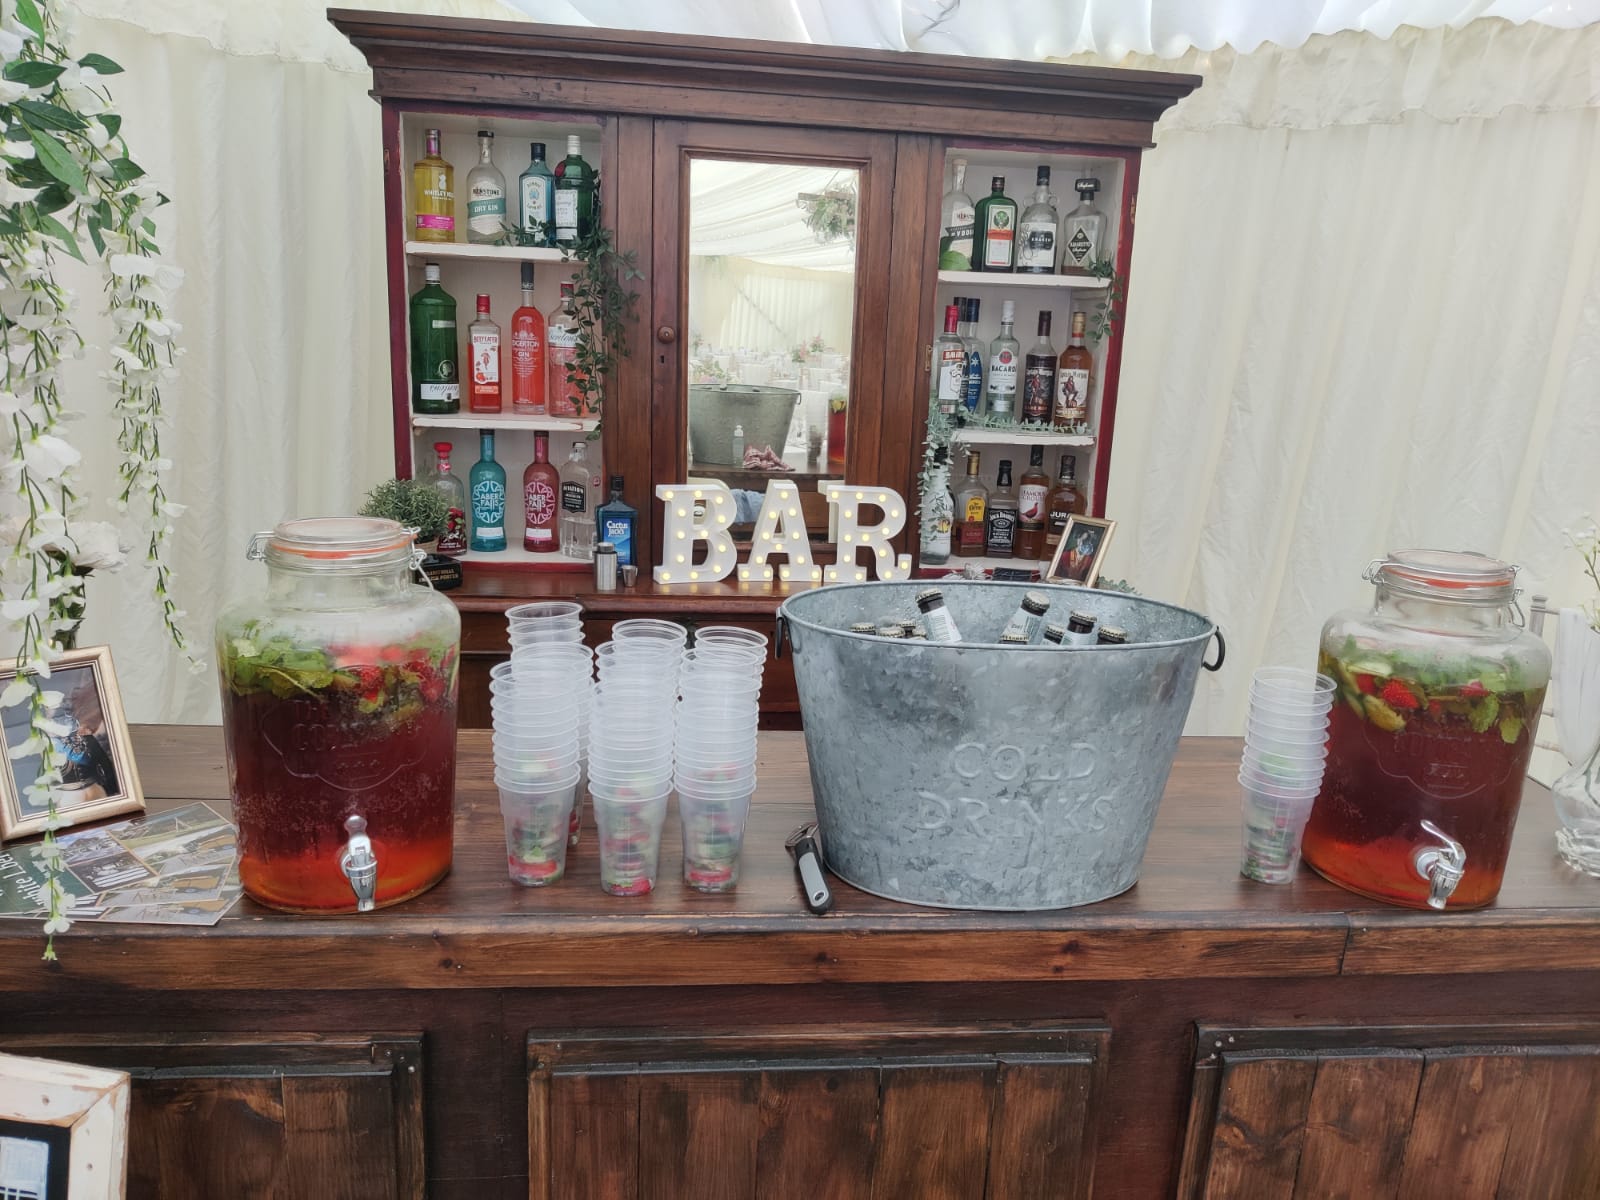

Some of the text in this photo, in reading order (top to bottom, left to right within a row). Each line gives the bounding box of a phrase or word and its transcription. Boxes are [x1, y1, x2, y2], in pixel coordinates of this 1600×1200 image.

[528, 494, 546, 502] ABER
[653, 479, 912, 585] BAR
[948, 742, 1097, 782] COLD
[916, 790, 1118, 839] DRINKS
